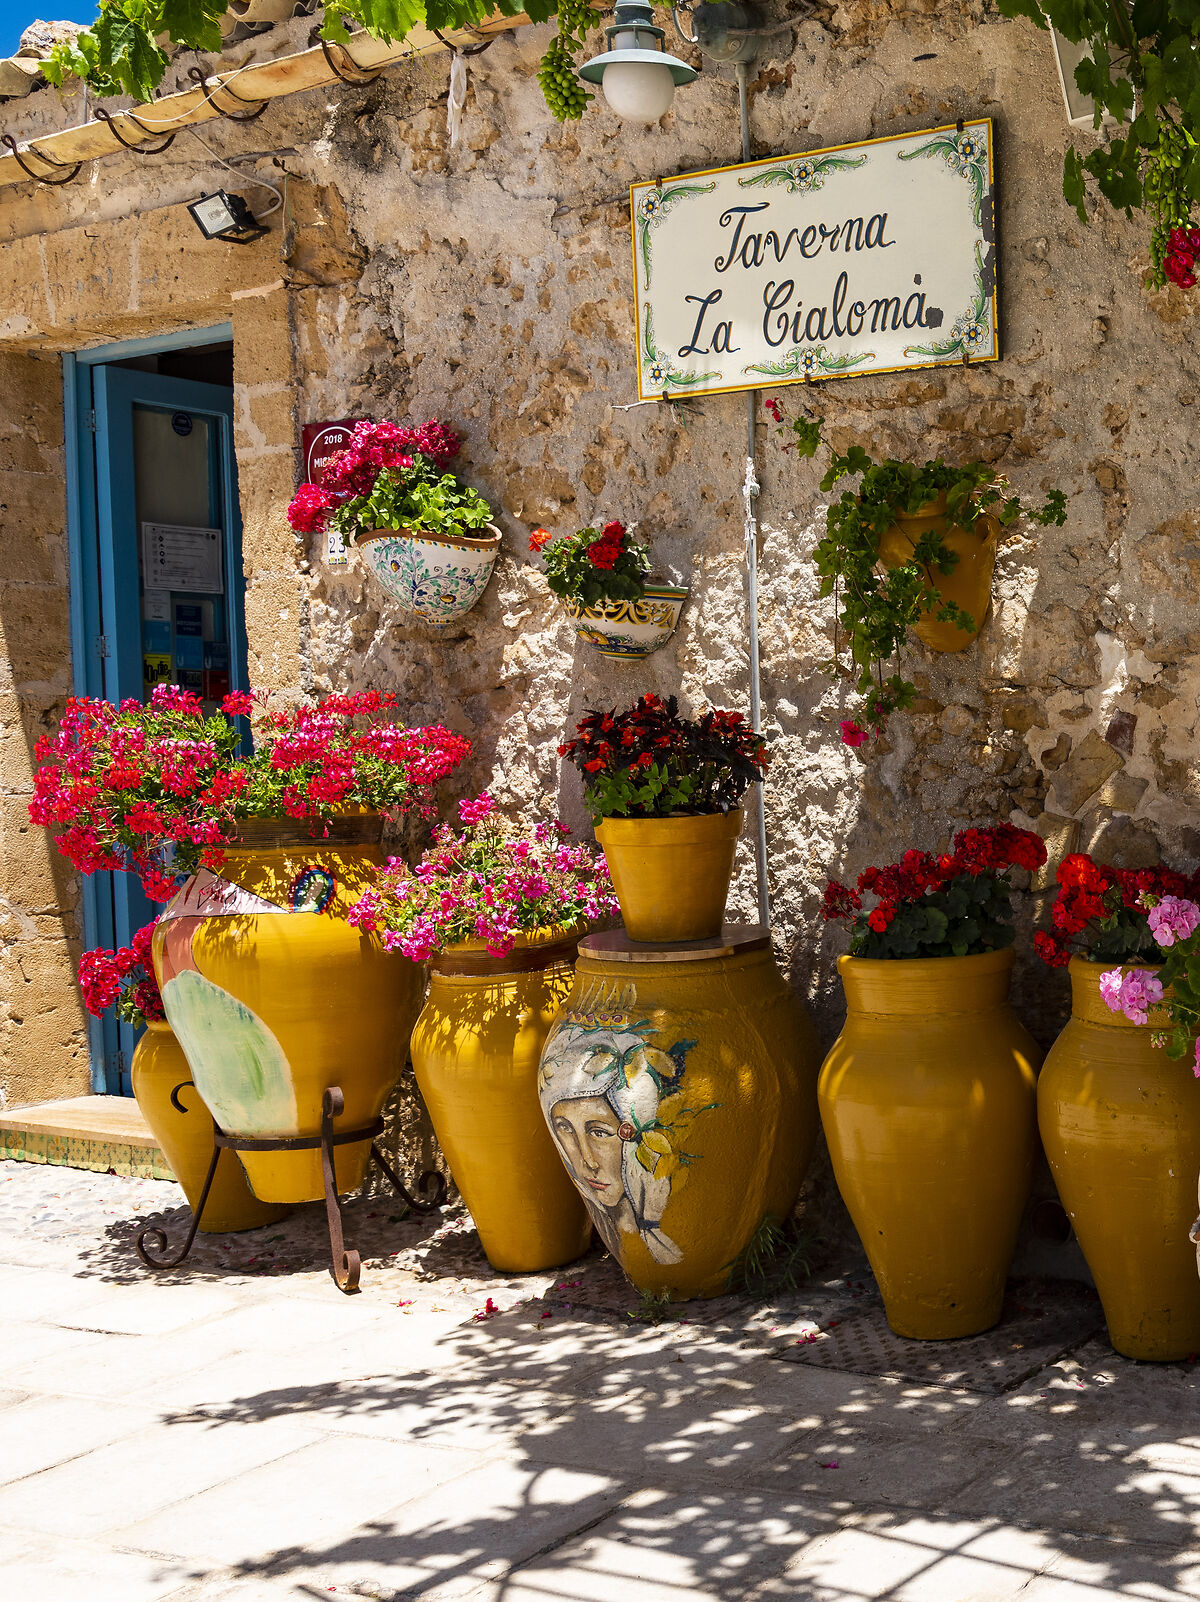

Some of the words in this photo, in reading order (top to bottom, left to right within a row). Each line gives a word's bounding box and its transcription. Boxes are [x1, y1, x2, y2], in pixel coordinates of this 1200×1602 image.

[714, 202, 896, 273] Taverna
[677, 289, 741, 358] La
[324, 434, 342, 445] 2018
[329, 537, 346, 553] 23
